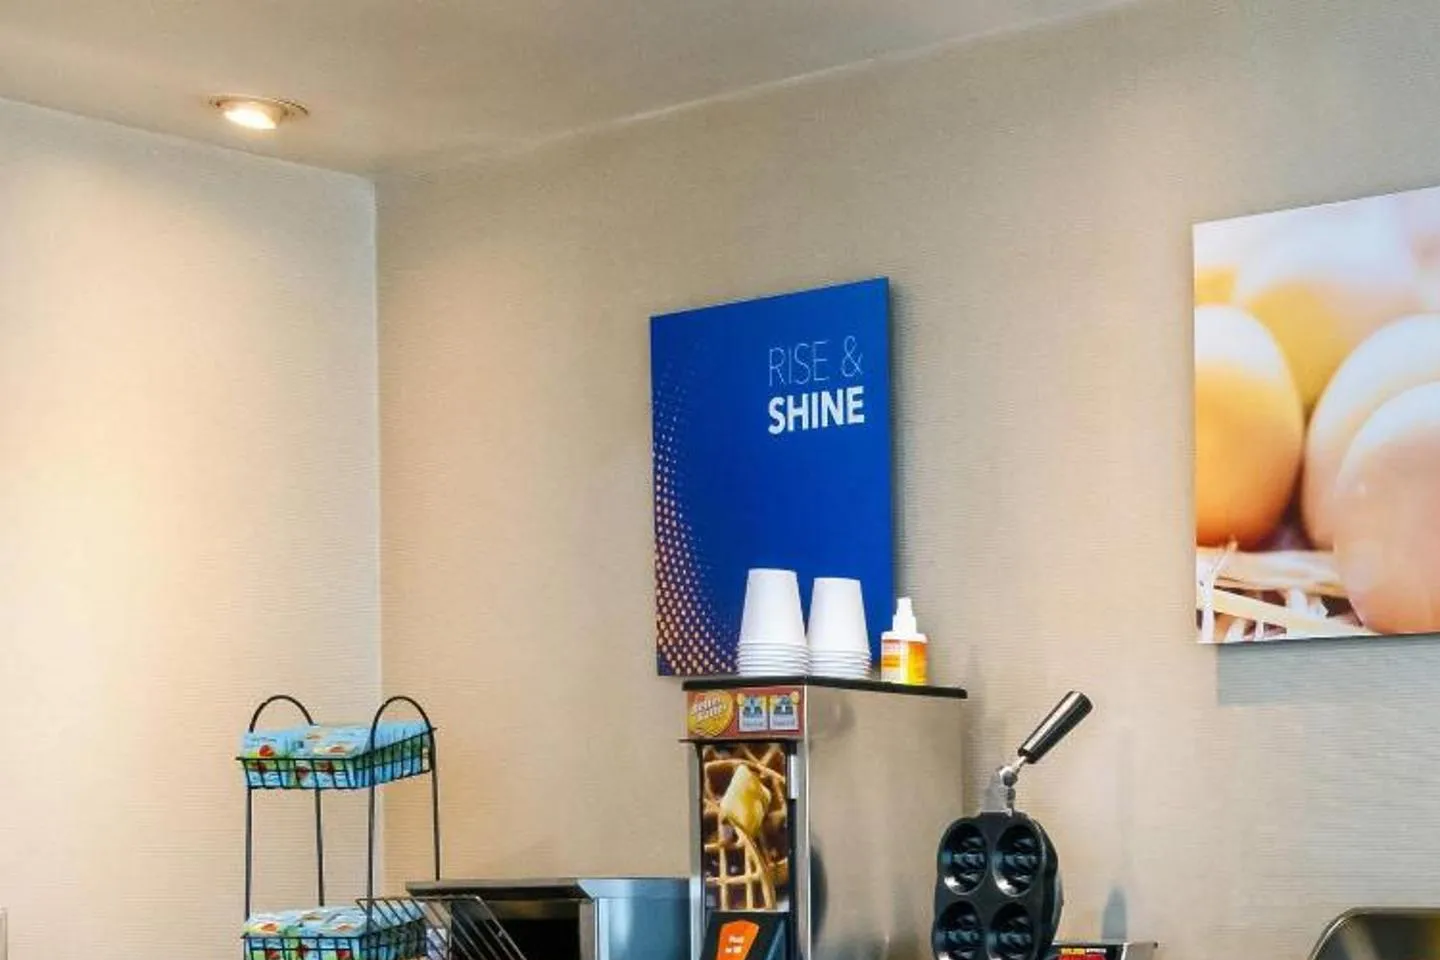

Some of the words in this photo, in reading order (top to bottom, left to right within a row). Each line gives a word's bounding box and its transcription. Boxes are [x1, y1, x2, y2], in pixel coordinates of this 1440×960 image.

[768, 340, 830, 386] RISE
[841, 335, 864, 378] &
[768, 386, 865, 435] SHINE
